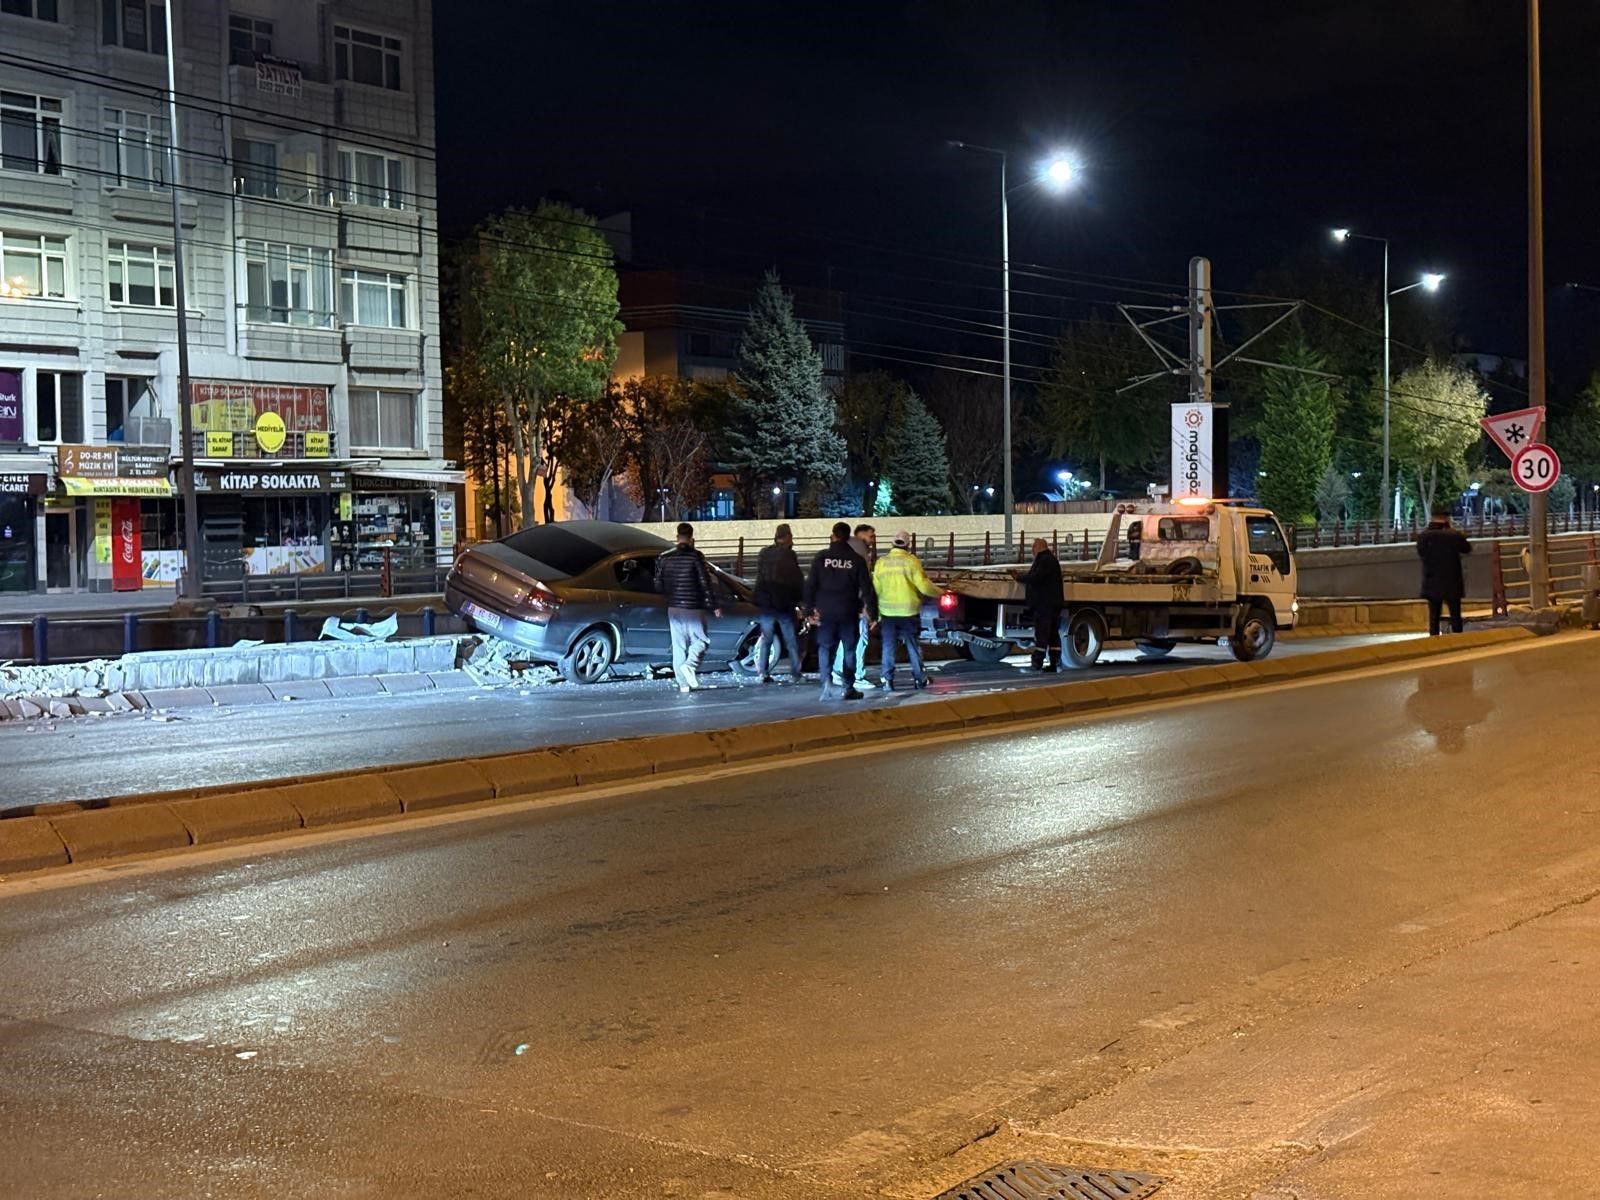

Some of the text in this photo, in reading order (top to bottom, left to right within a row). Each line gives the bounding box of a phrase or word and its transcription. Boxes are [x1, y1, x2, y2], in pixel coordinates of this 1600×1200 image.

[256, 63, 301, 88] SATILIK
[1186, 430, 1201, 496] mayagöz
[1522, 457, 1550, 479] 30
[220, 472, 258, 489] KİTAP
[261, 475, 320, 489] SOKAKTA
